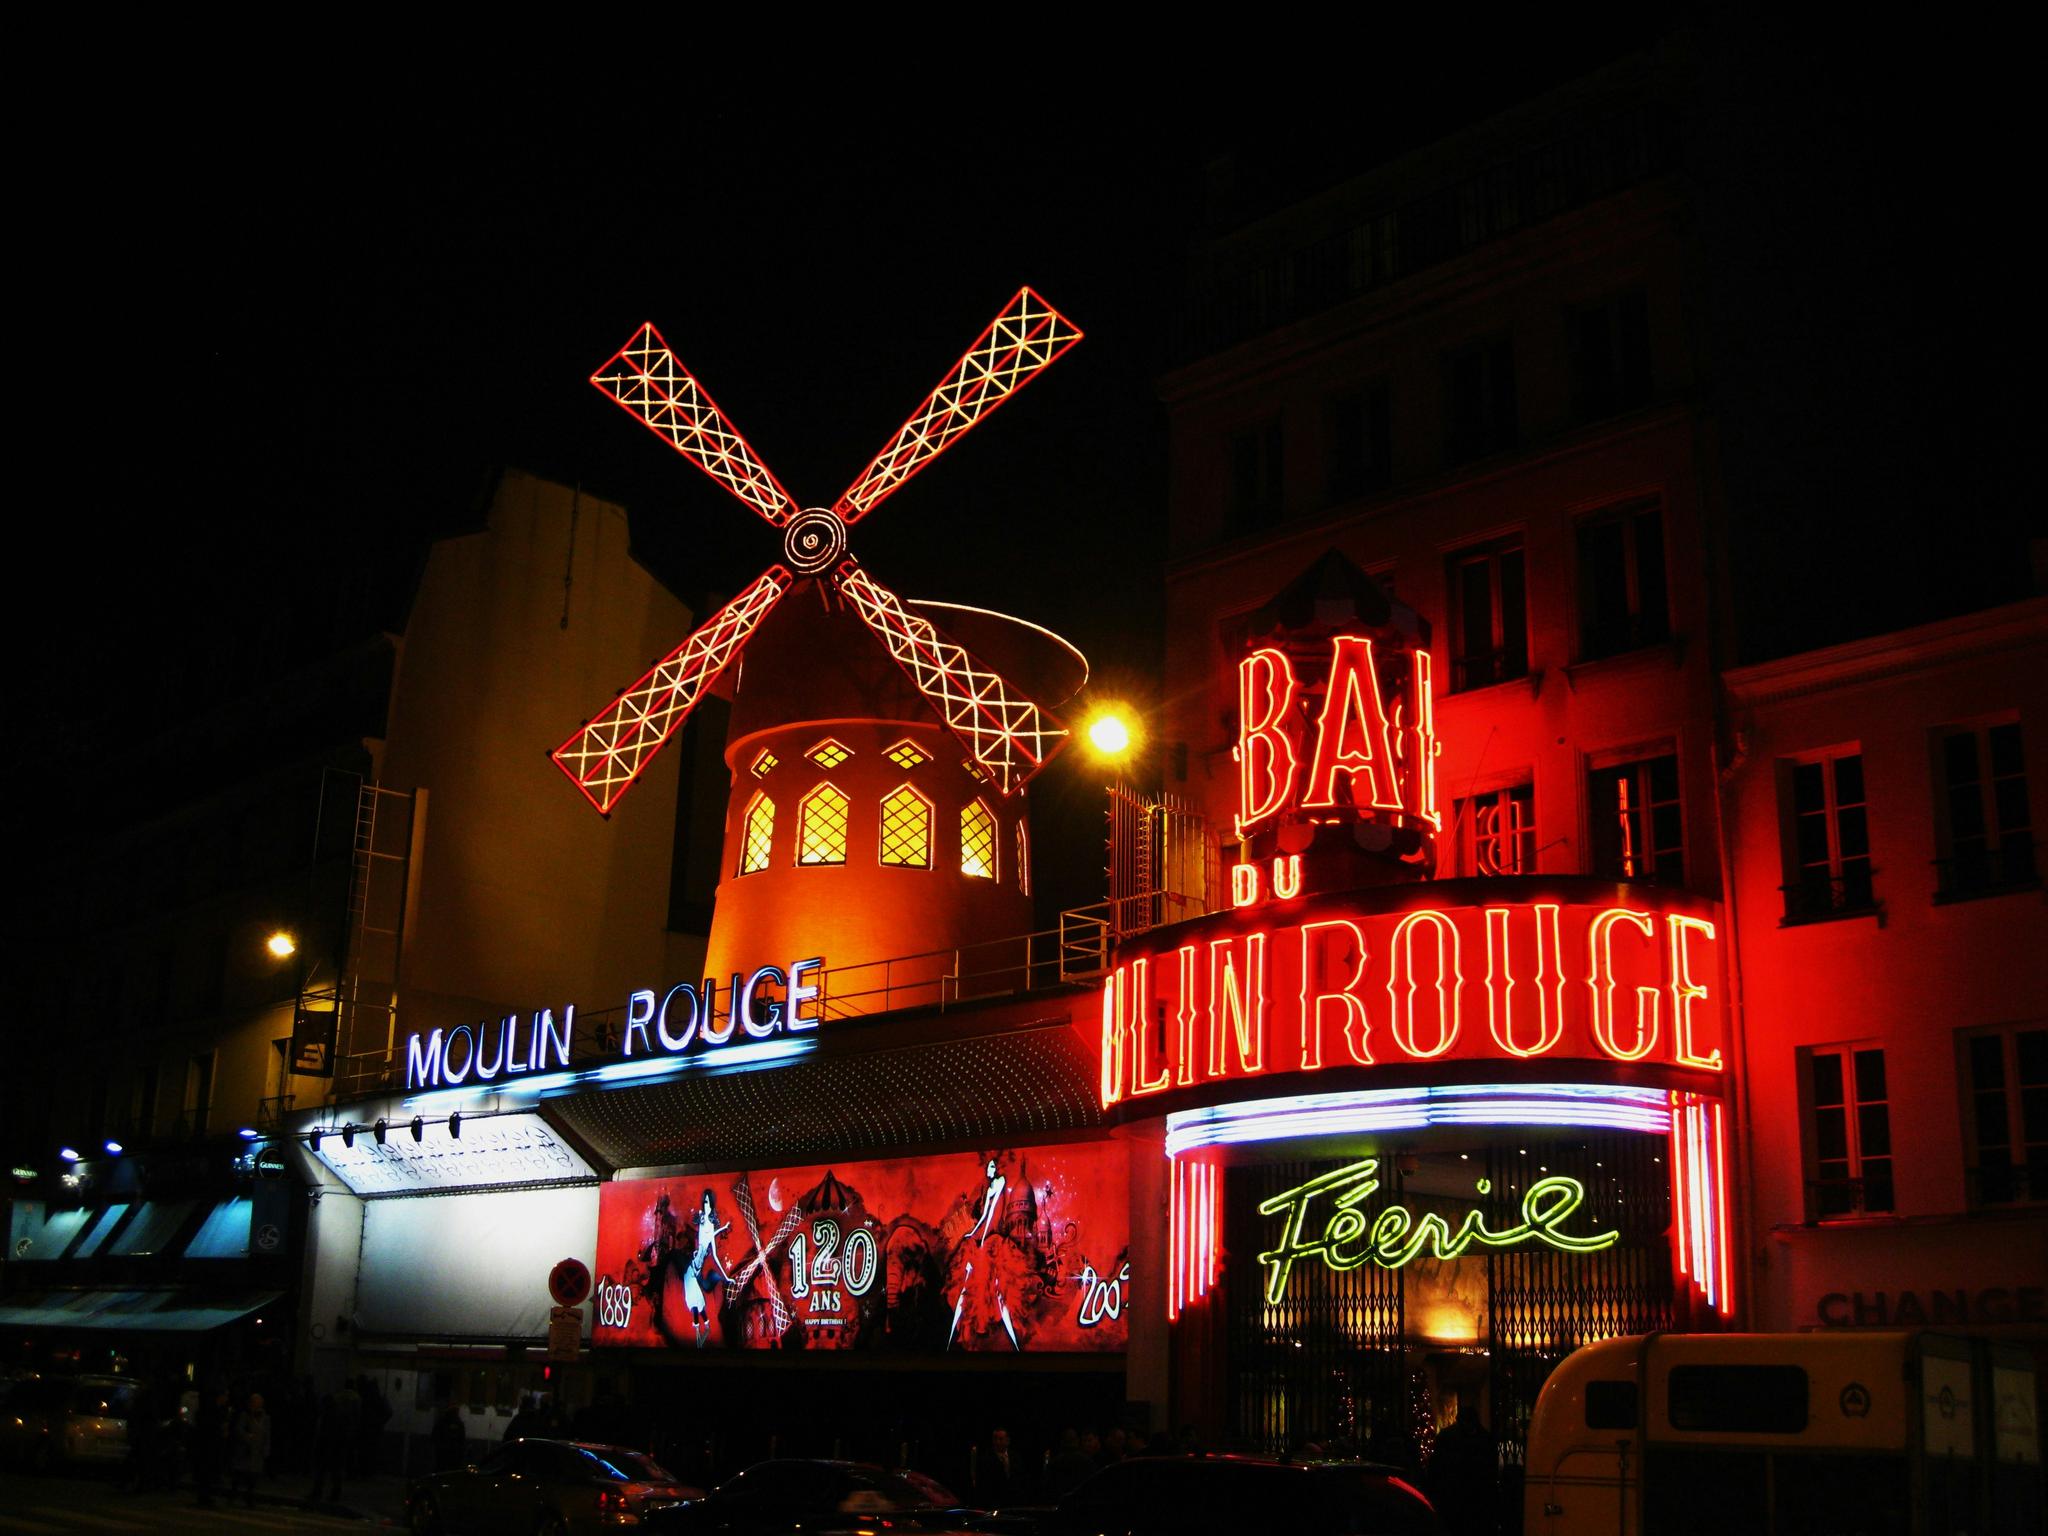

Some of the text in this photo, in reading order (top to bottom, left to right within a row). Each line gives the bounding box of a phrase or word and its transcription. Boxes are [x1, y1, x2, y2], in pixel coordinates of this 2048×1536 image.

[1231, 854, 1301, 908] DU
[1299, 904, 1723, 1071] ROUGE
[406, 956, 826, 1091] MOULIN ROUGE
[788, 1219, 878, 1299] 120
[597, 1275, 632, 1328] 1889
[809, 1290, 842, 1313] ANS
[1816, 1287, 2046, 1328] CHANGE
